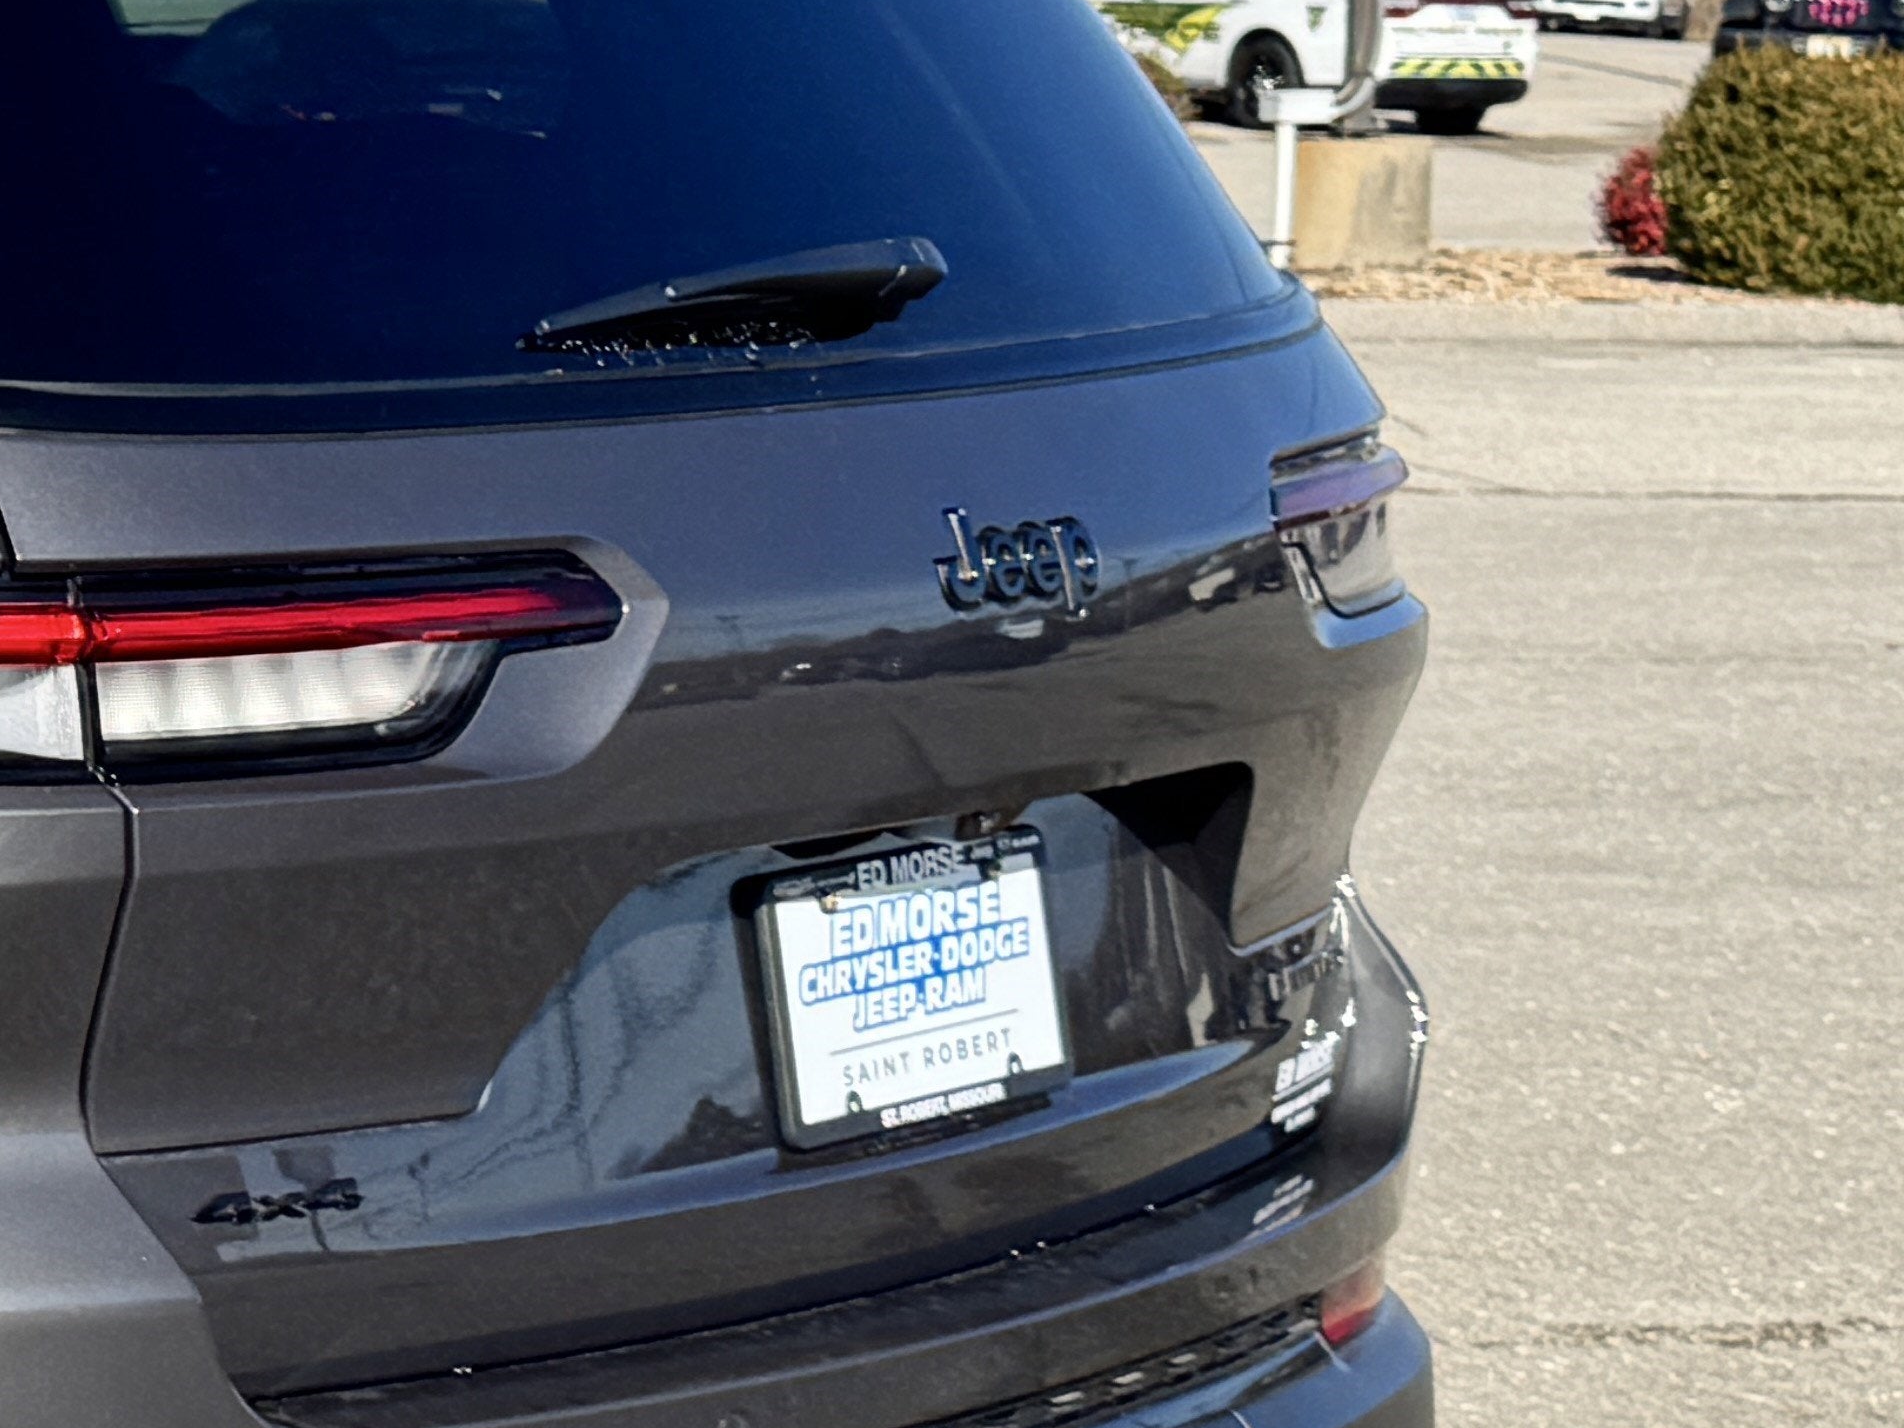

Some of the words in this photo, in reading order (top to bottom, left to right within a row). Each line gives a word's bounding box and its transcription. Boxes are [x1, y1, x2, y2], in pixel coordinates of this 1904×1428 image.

[932, 506, 1098, 620] Jeep
[831, 904, 874, 957] ED
[877, 883, 1000, 948] MORSE
[842, 1051, 911, 1088] SAINT
[922, 1027, 1013, 1075] ROBERT
